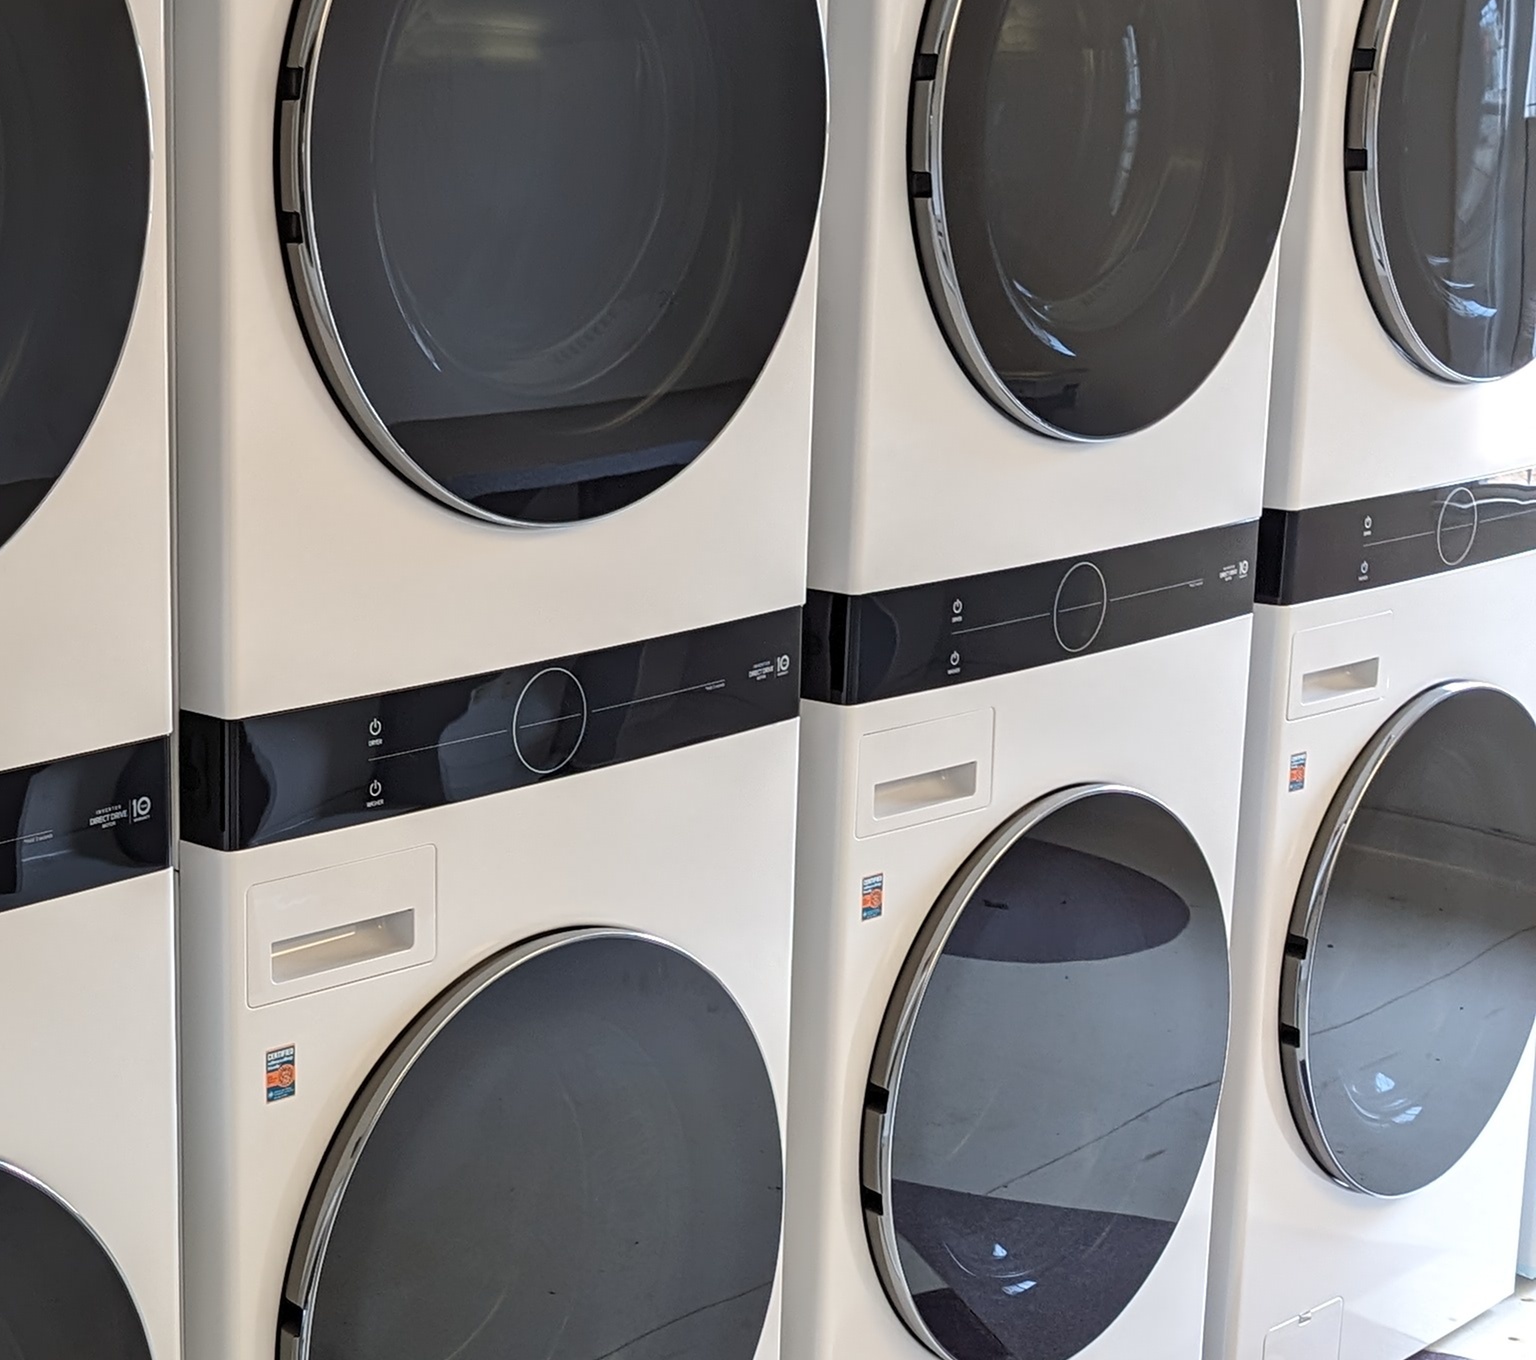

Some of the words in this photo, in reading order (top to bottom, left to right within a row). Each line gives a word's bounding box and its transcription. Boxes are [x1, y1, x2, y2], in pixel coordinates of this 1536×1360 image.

[776, 654, 790, 672] 10
[132, 796, 151, 817] 10
[89, 813, 110, 826] DIRECT
[110, 809, 128, 820] DRIVE
